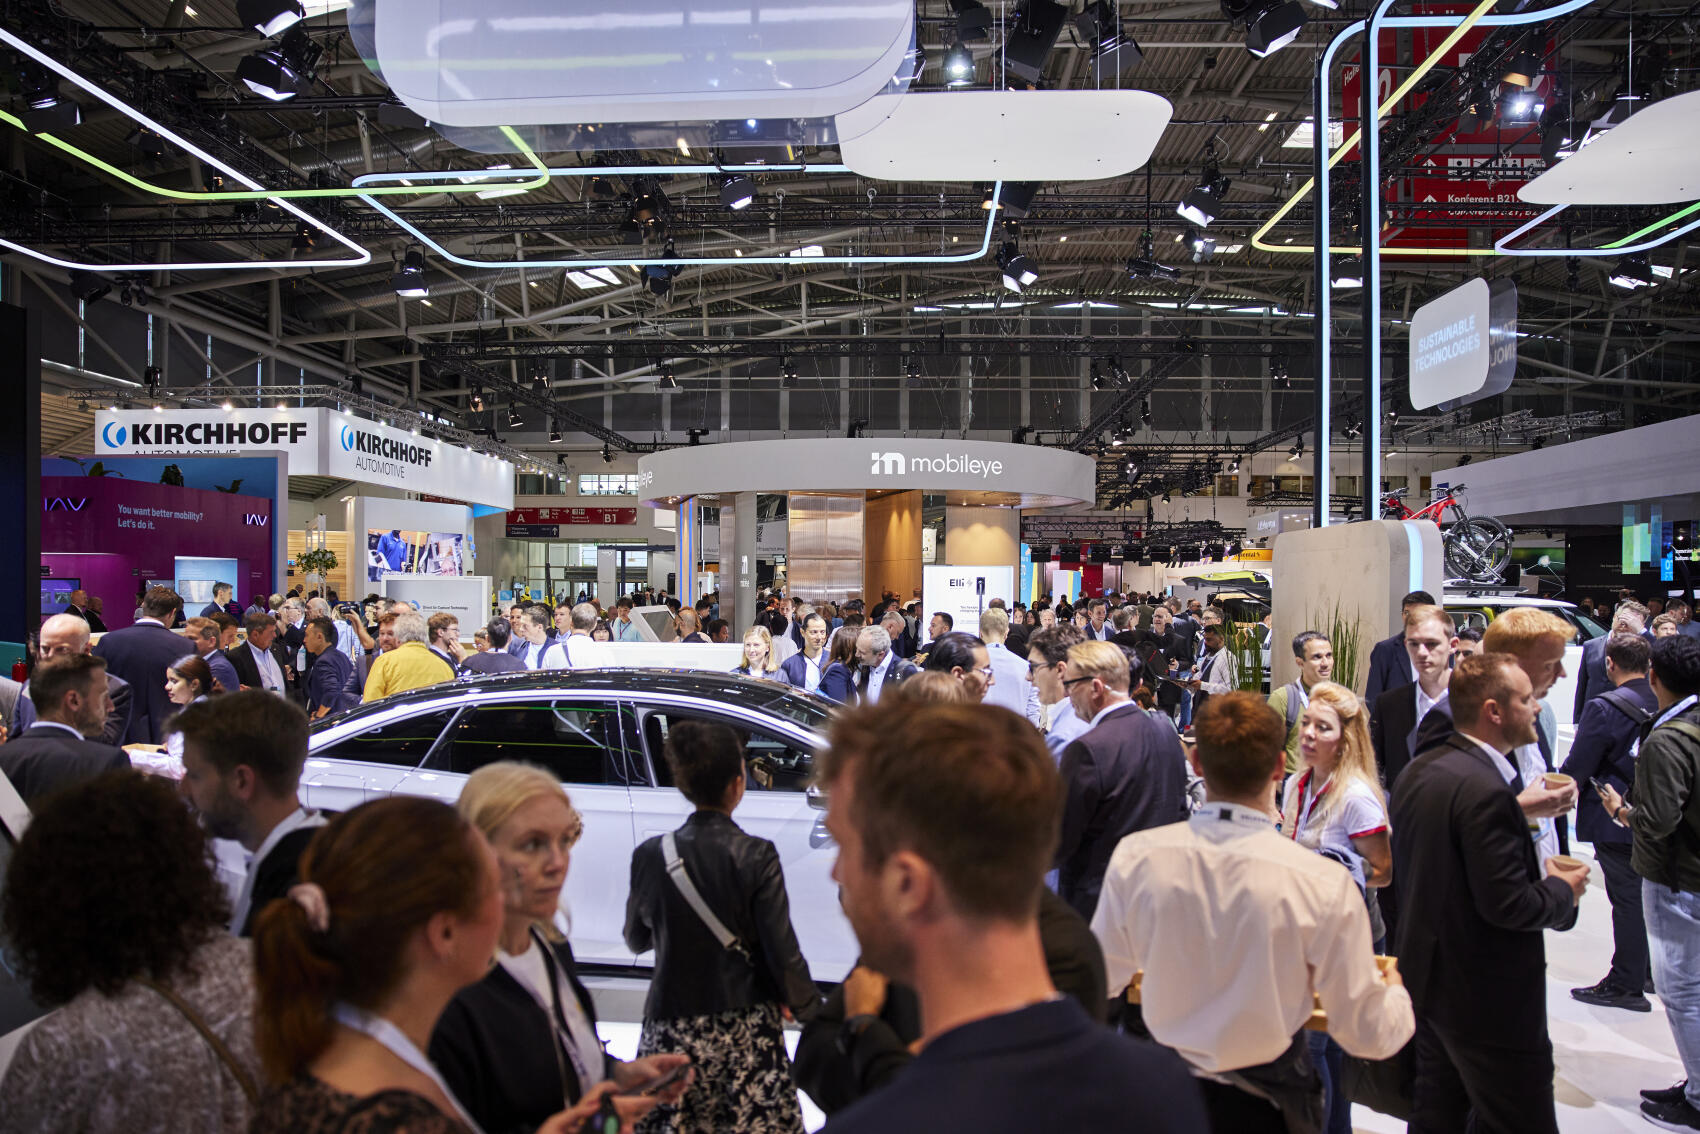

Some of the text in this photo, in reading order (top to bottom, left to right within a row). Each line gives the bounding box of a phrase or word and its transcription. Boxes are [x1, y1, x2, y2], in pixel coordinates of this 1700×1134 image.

[1448, 194, 1494, 203] Konferenz
[1418, 315, 1476, 352] SUSTAINABLE
[1414, 333, 1481, 373] TECHNOLOGIES
[131, 423, 307, 445] KIRCHHOFF
[355, 430, 432, 467] KIRCHHOFF
[355, 456, 405, 478] AUTOMOTIVE
[911, 453, 1003, 478] mobileye
[118, 503, 203, 523] You want better mobility?
[246, 513, 268, 526] IAV
[516, 513, 526, 523] A
[604, 513, 617, 523] B1
[117, 517, 156, 530] Let's do it.
[949, 578, 965, 587] Elli
